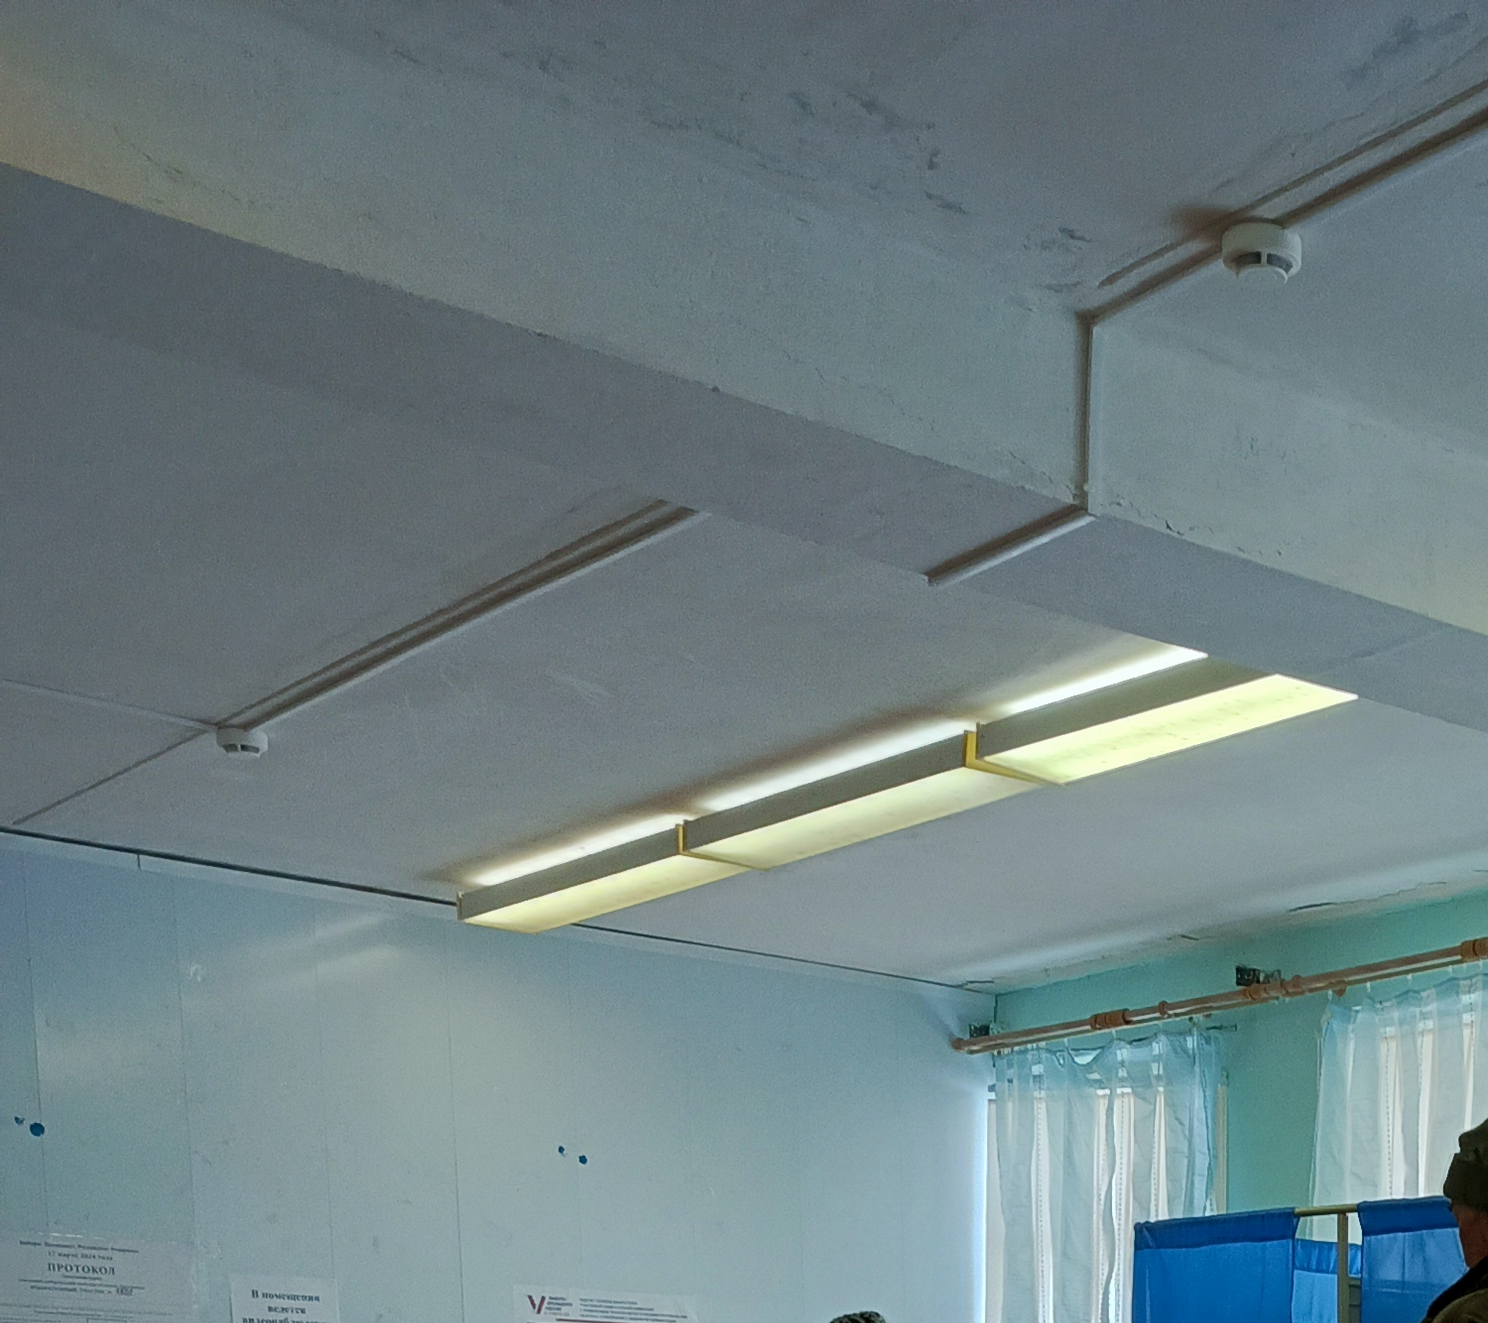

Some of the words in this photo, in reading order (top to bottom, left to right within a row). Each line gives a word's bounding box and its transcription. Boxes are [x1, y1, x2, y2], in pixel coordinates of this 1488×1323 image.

[46, 1262, 116, 1276] ПРОТОКОЛ
[251, 1289, 259, 1299] В
[261, 1292, 321, 1303] помещении
